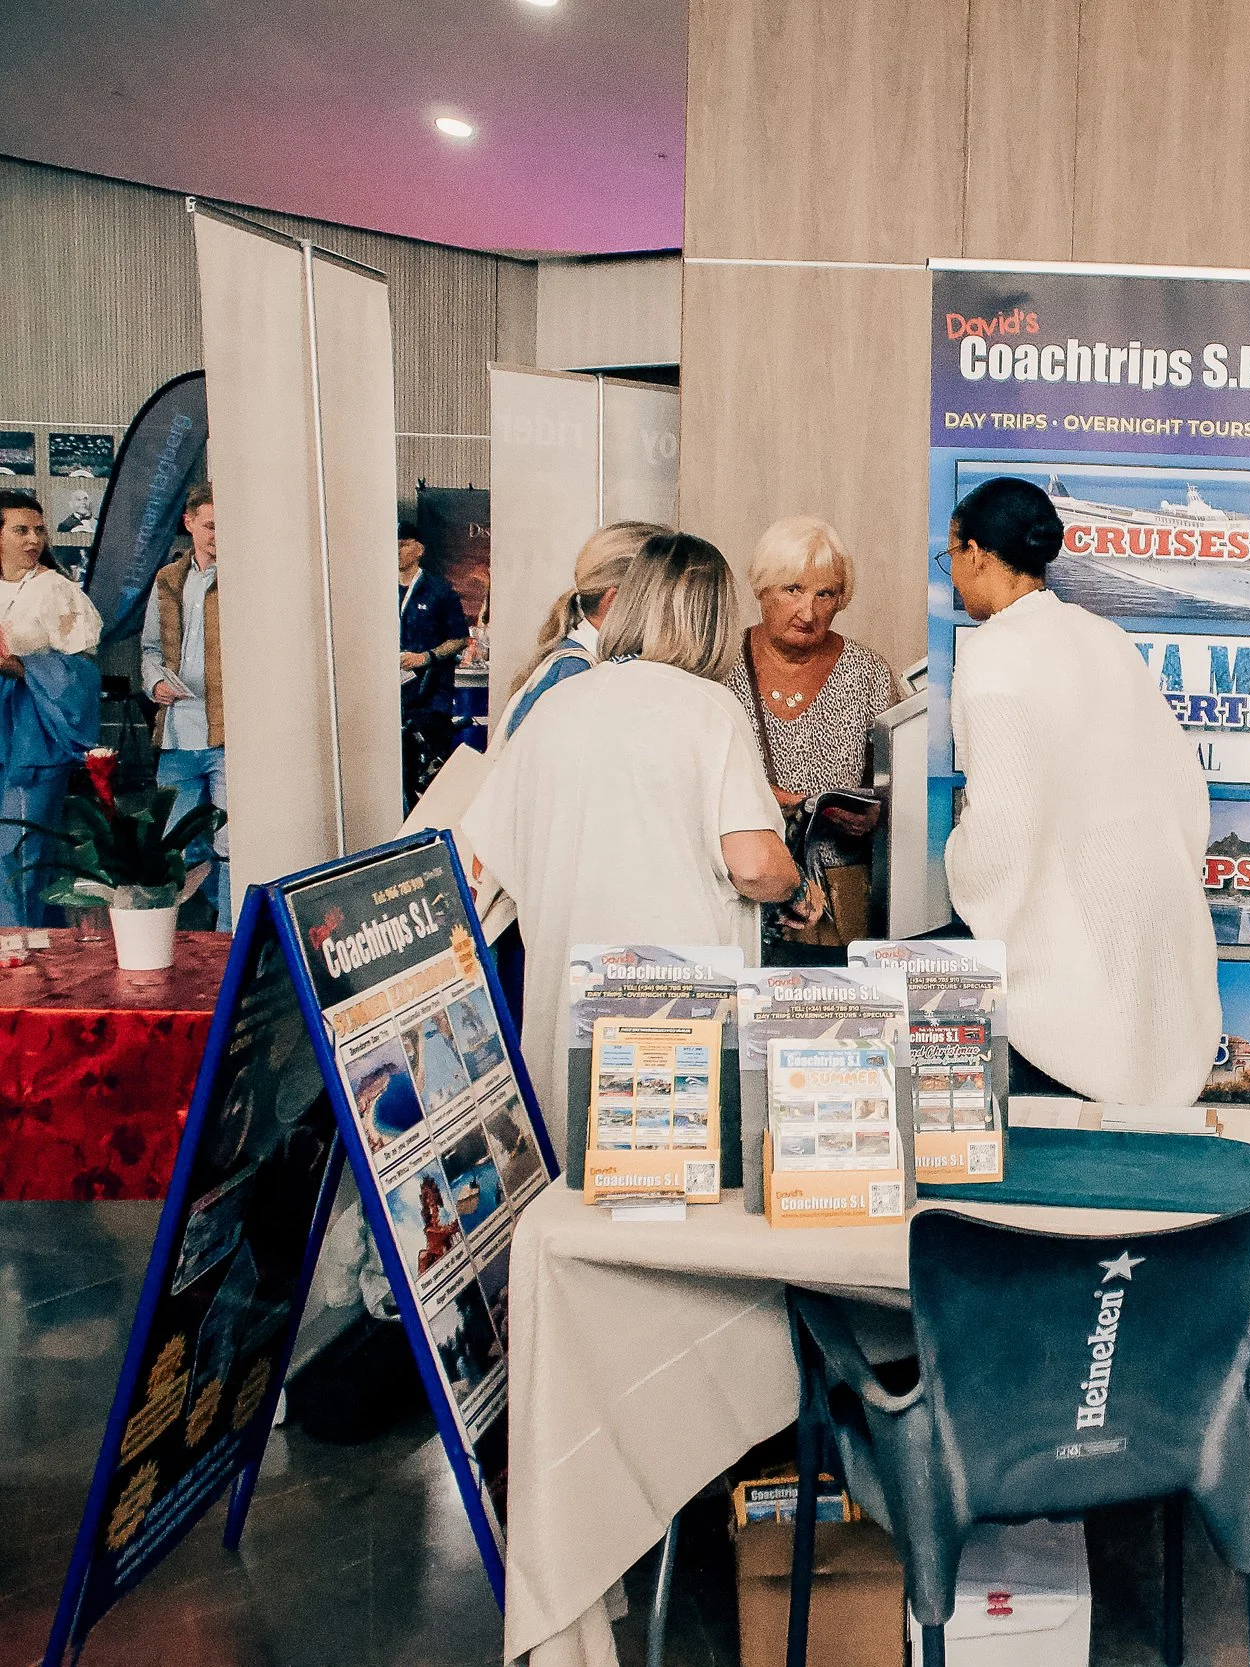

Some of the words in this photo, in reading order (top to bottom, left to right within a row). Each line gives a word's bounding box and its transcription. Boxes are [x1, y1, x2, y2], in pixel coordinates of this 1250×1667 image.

[945, 308, 1039, 340] David's
[959, 335, 1192, 389] Coachtrips
[944, 412, 988, 430] DAY
[990, 413, 1048, 431] TRIPS
[1063, 415, 1183, 436] OVERNIGHT
[322, 913, 413, 978] Coachtrips
[606, 964, 691, 981] Coachtrips
[774, 986, 857, 1002] Coachtrips
[809, 1070, 878, 1085] SUMMER
[594, 1173, 662, 1187] Coachtrips
[781, 1195, 848, 1211] Coachtrips
[1077, 1289, 1124, 1430] Heineken
